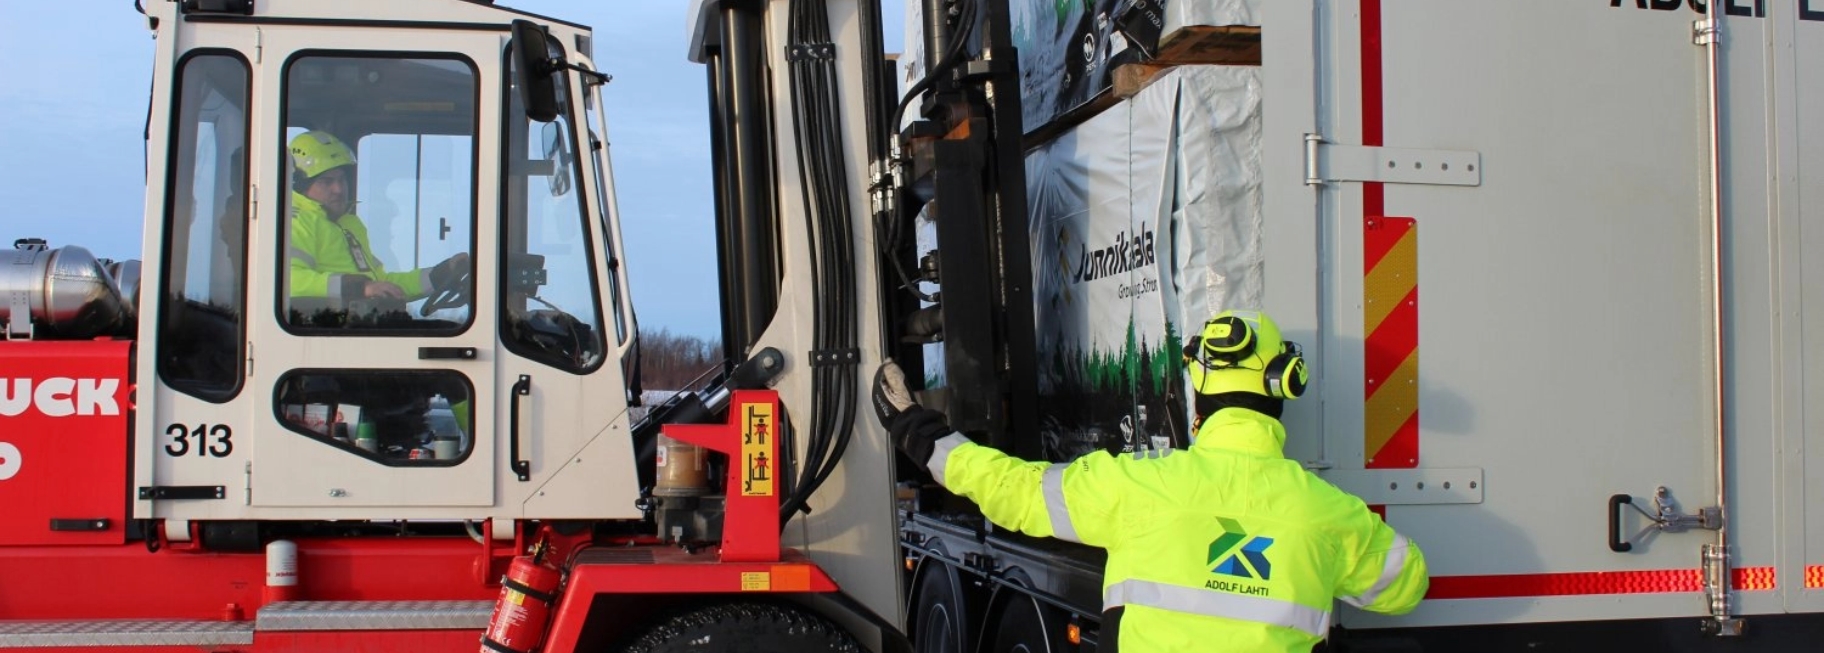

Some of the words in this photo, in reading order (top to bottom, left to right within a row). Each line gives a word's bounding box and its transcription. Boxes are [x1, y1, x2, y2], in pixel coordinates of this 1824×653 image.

[164, 423, 234, 458] 313
[1205, 579, 1238, 592] ADOLF
[1239, 584, 1269, 597] LAHTI
